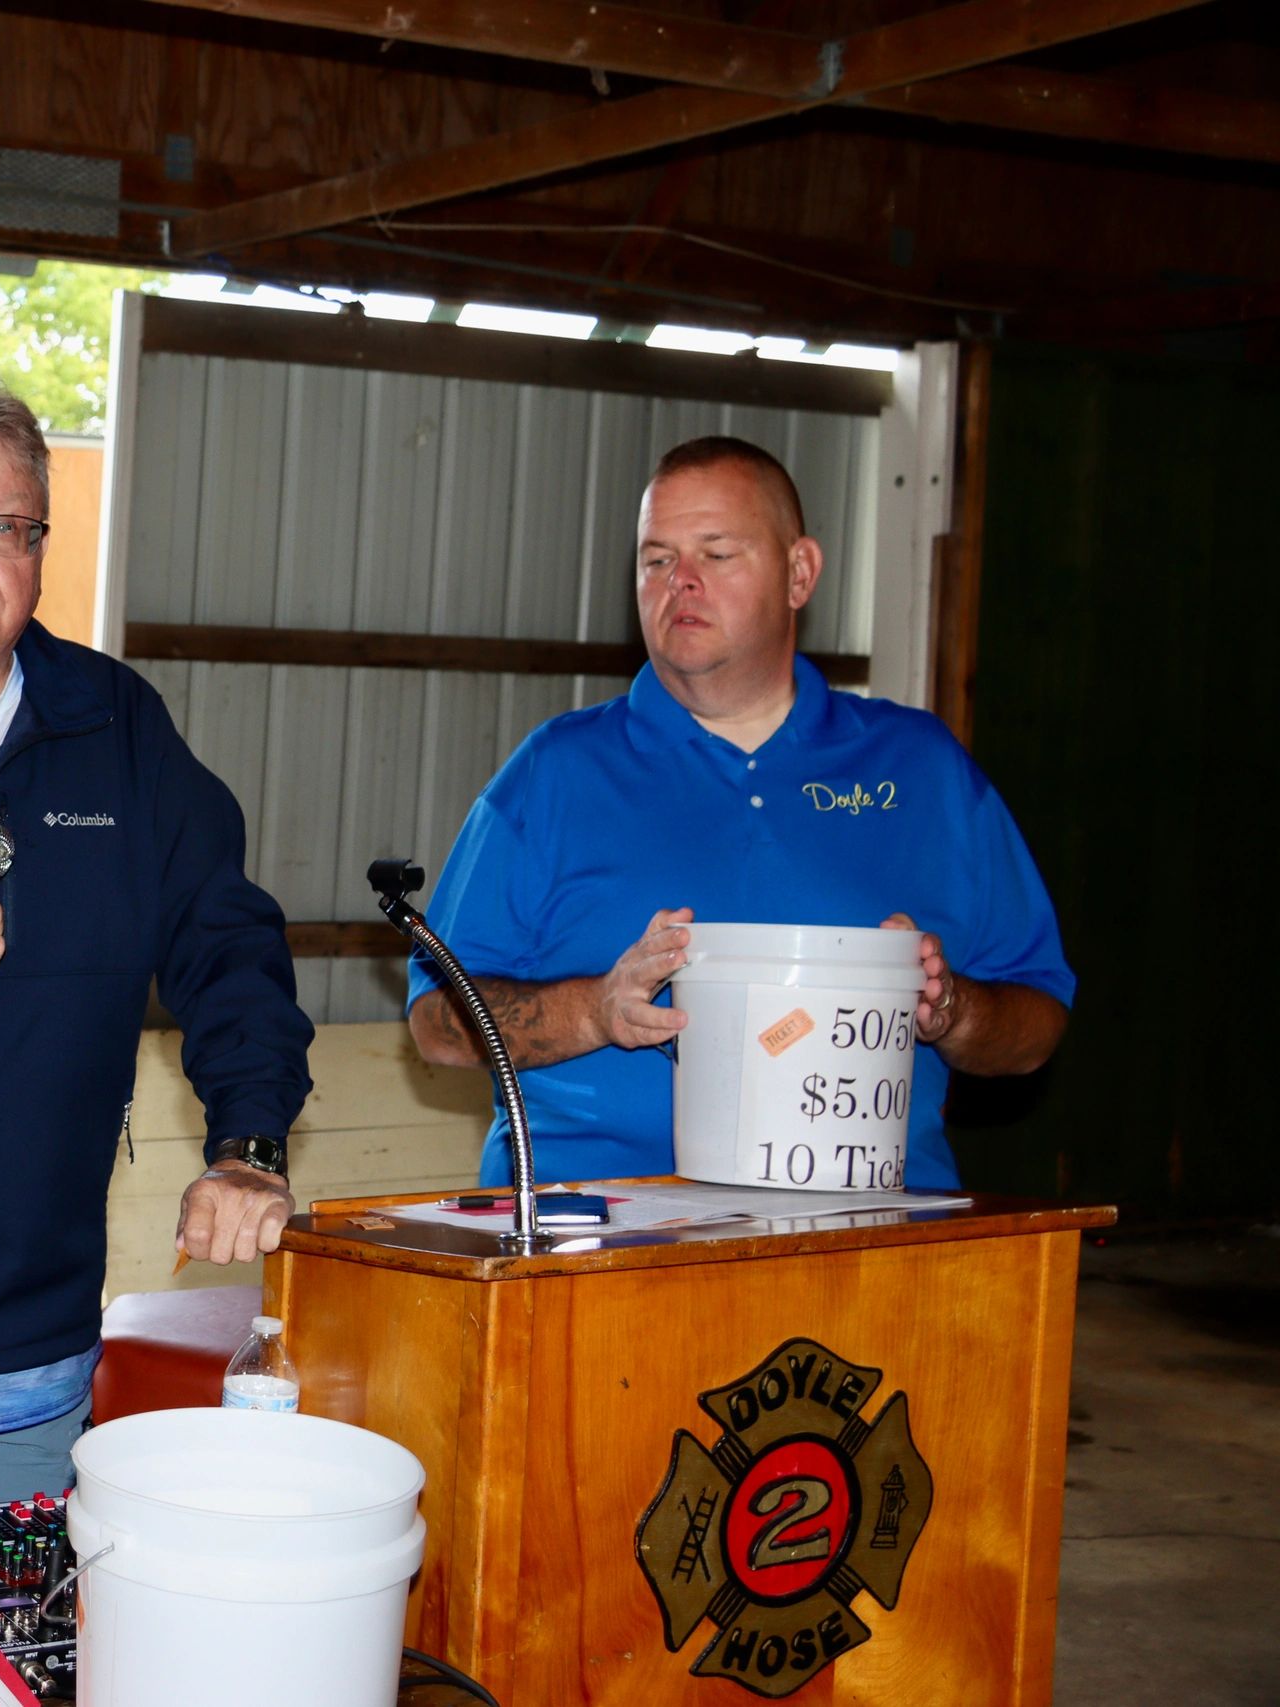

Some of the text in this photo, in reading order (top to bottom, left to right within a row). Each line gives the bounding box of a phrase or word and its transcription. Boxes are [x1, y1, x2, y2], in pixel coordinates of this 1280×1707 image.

[57, 812, 115, 826] Columbia
[802, 781, 898, 815] Doyle 2
[765, 1019, 799, 1048] TICKET
[800, 1072, 907, 1123] $5.00
[757, 1141, 815, 1186] 10
[726, 1354, 867, 1433] DOYLE
[747, 1474, 833, 1571] 2
[721, 1609, 851, 1677] HOSE
